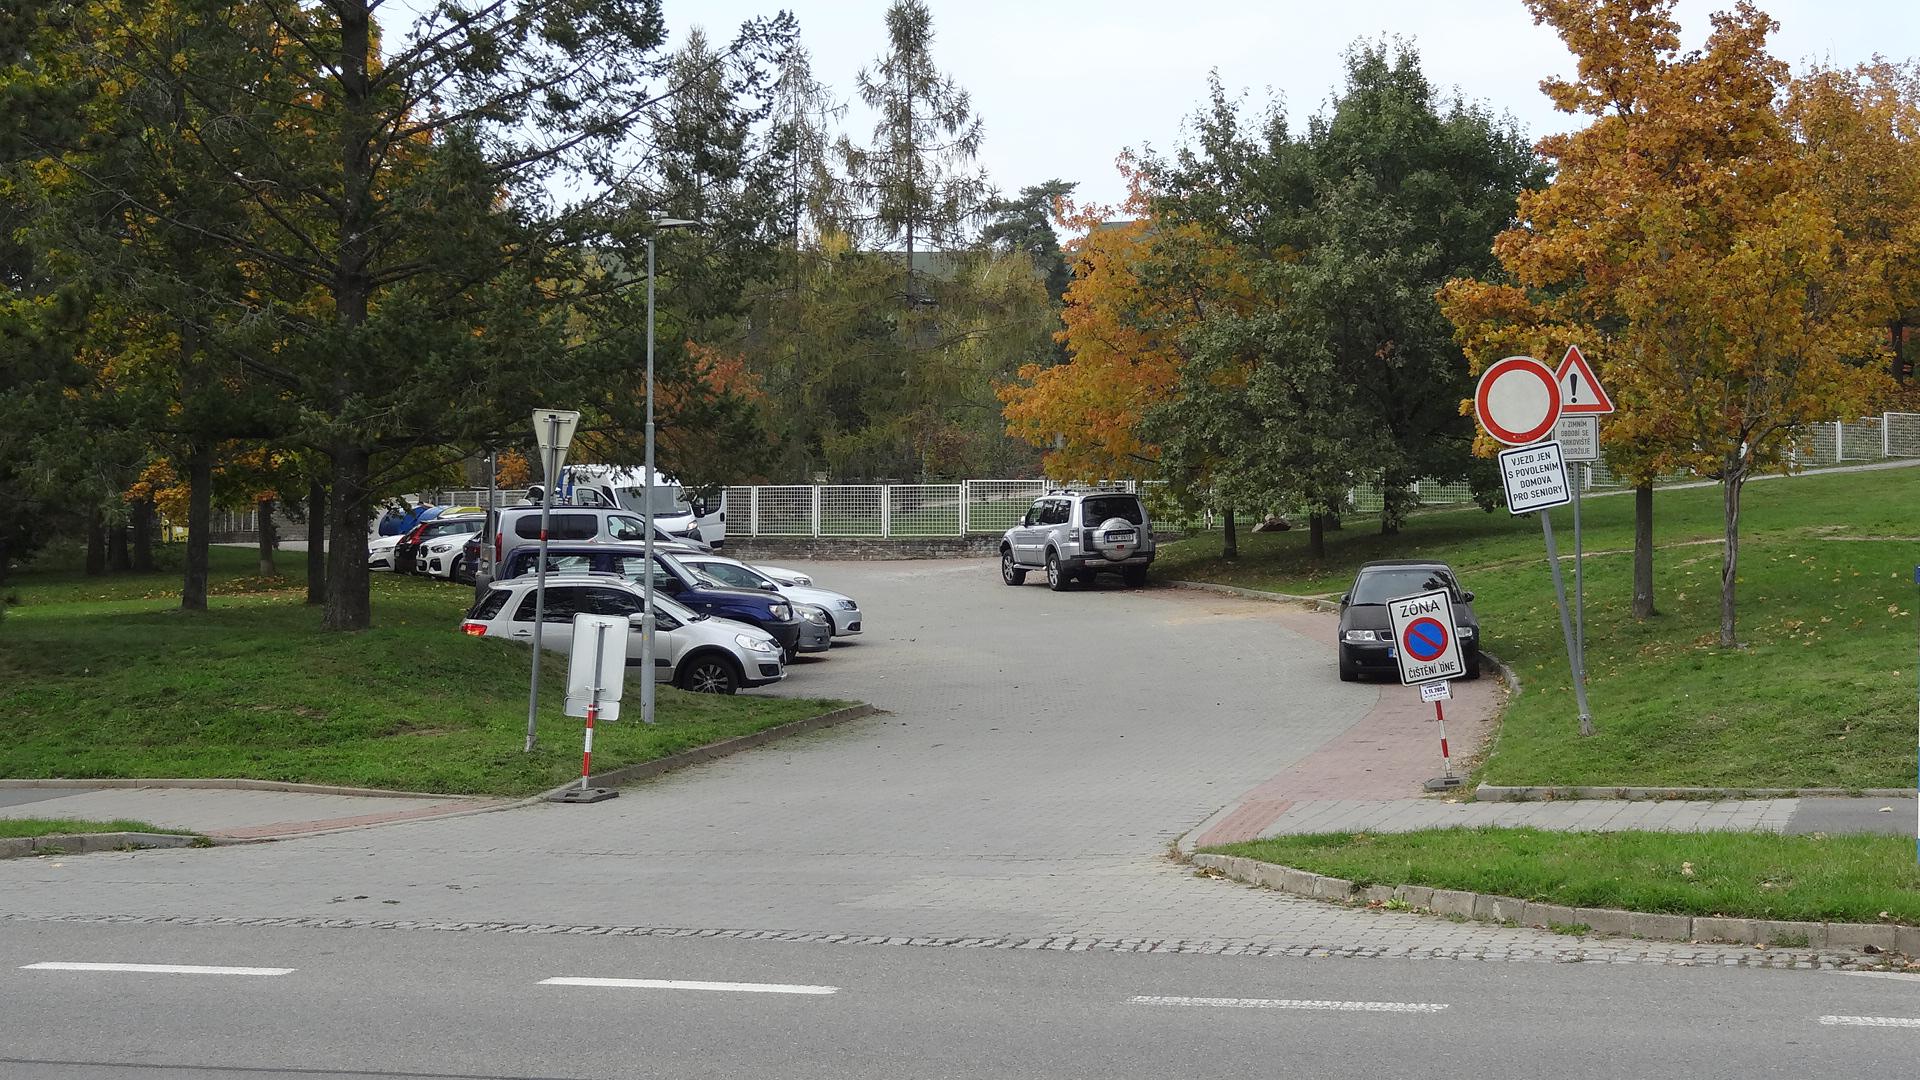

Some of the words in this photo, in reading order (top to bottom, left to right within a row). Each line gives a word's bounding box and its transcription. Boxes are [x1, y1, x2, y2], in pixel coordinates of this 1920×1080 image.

[1567, 420, 1587, 428] ZIMNÍM
[1561, 429, 1580, 437] OBDOBÍ
[1581, 429, 1589, 437] SE
[1511, 454, 1535, 466] VJEZD
[1536, 451, 1551, 462] JEN
[1562, 447, 1591, 455] EUDRŽUJE
[1508, 470, 1513, 479] S
[1515, 462, 1559, 477] POVOLENÍM
[1520, 476, 1552, 488] DOMOVA
[1513, 492, 1529, 503] PRO
[1530, 485, 1563, 498] SENIORY
[1400, 600, 1440, 618] ZÓNA
[1408, 663, 1437, 678] ČIŠTĚNÍ
[1439, 661, 1455, 672] DNE
